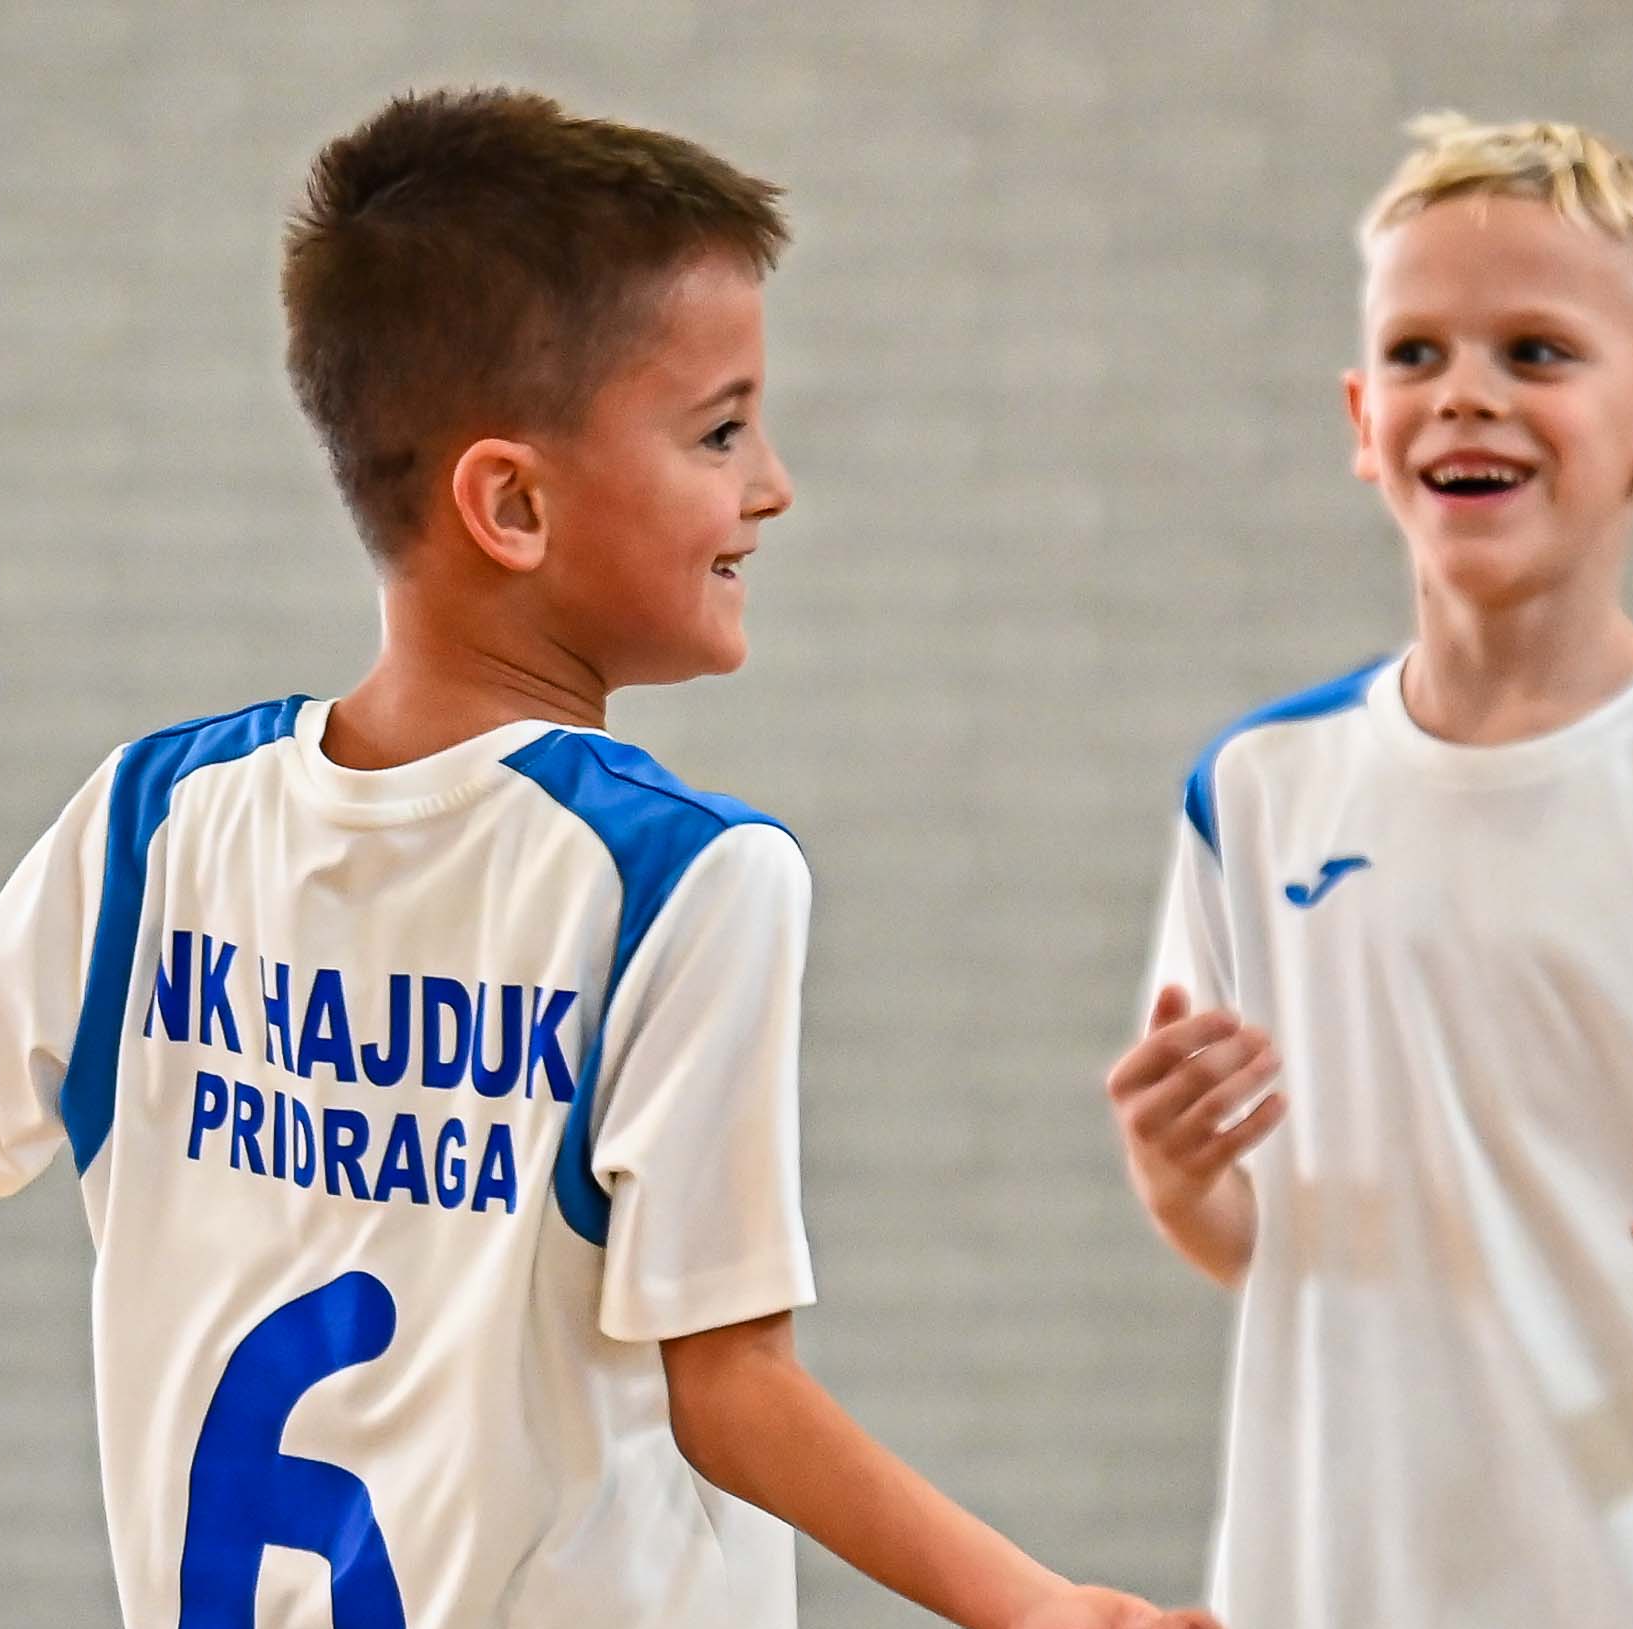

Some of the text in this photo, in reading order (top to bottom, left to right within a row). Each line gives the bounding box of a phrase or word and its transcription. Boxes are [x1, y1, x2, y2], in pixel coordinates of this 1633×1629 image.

[143, 930, 578, 1104] NK HAJDUK
[186, 1070, 518, 1215] PRIDRAGA
